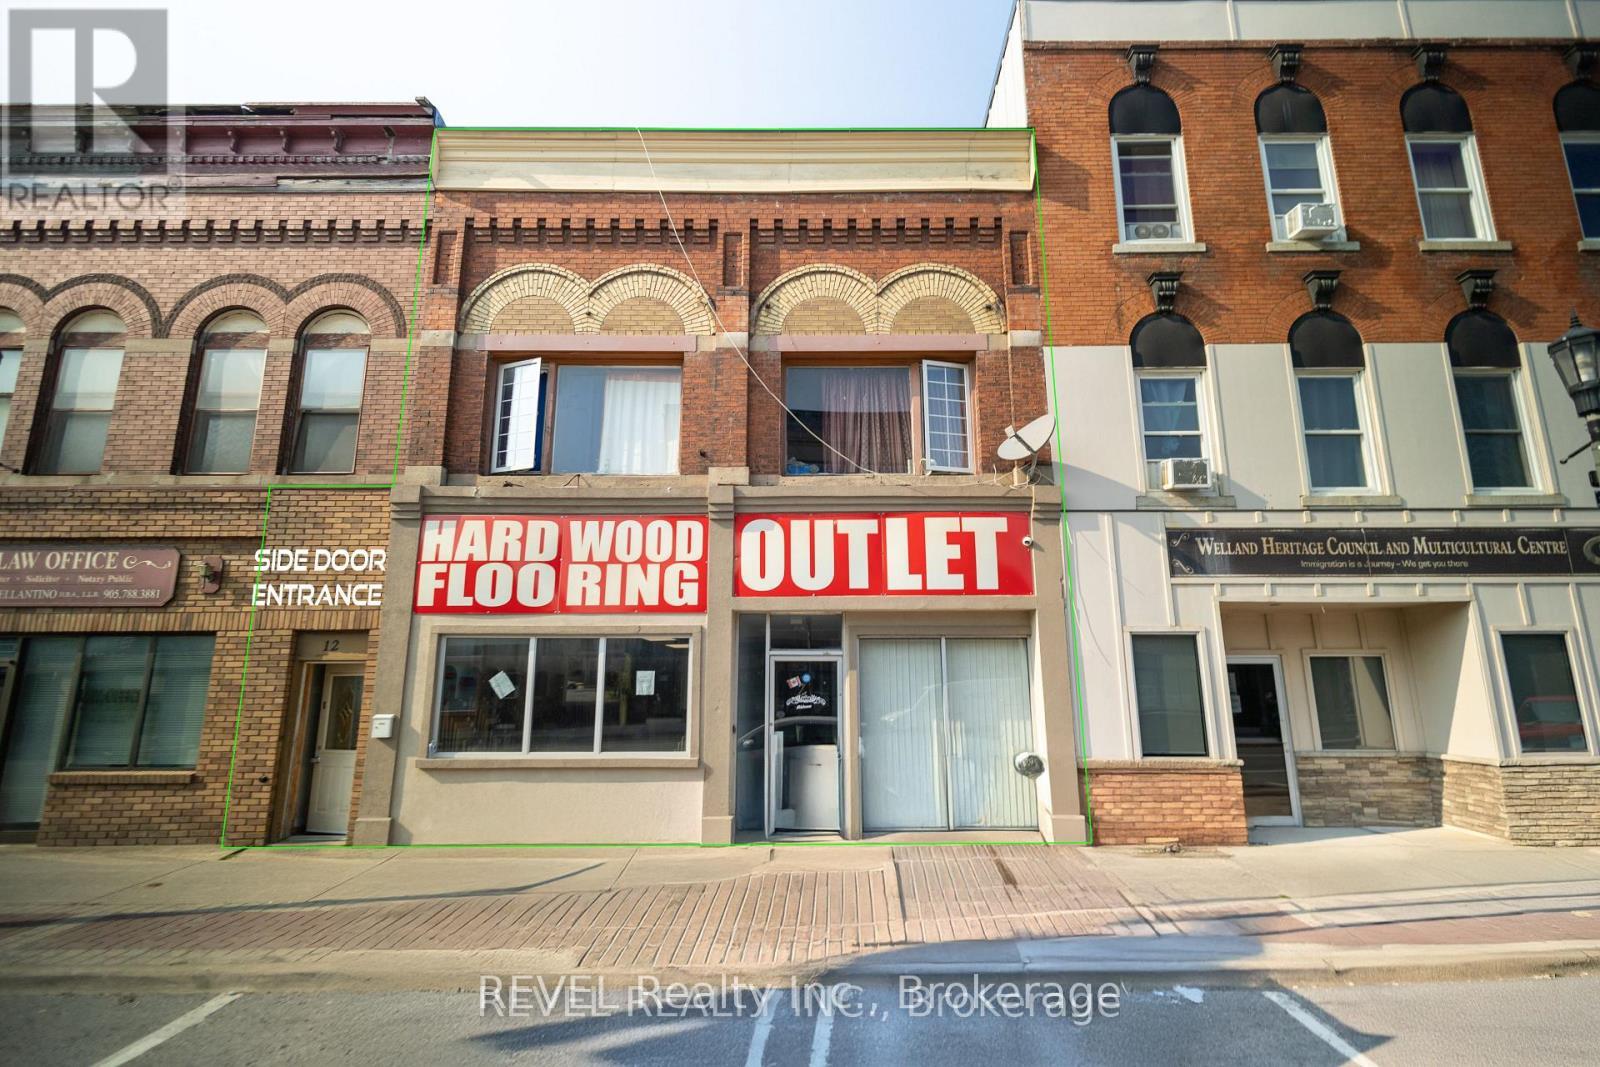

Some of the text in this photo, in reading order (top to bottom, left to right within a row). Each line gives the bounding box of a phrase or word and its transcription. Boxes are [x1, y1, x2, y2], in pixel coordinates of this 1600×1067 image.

[421, 520, 704, 562] HARD WOOD
[741, 517, 1008, 591] OUTLET
[0, 551, 119, 570] LAW OFFICE
[323, 640, 340, 652] 12
